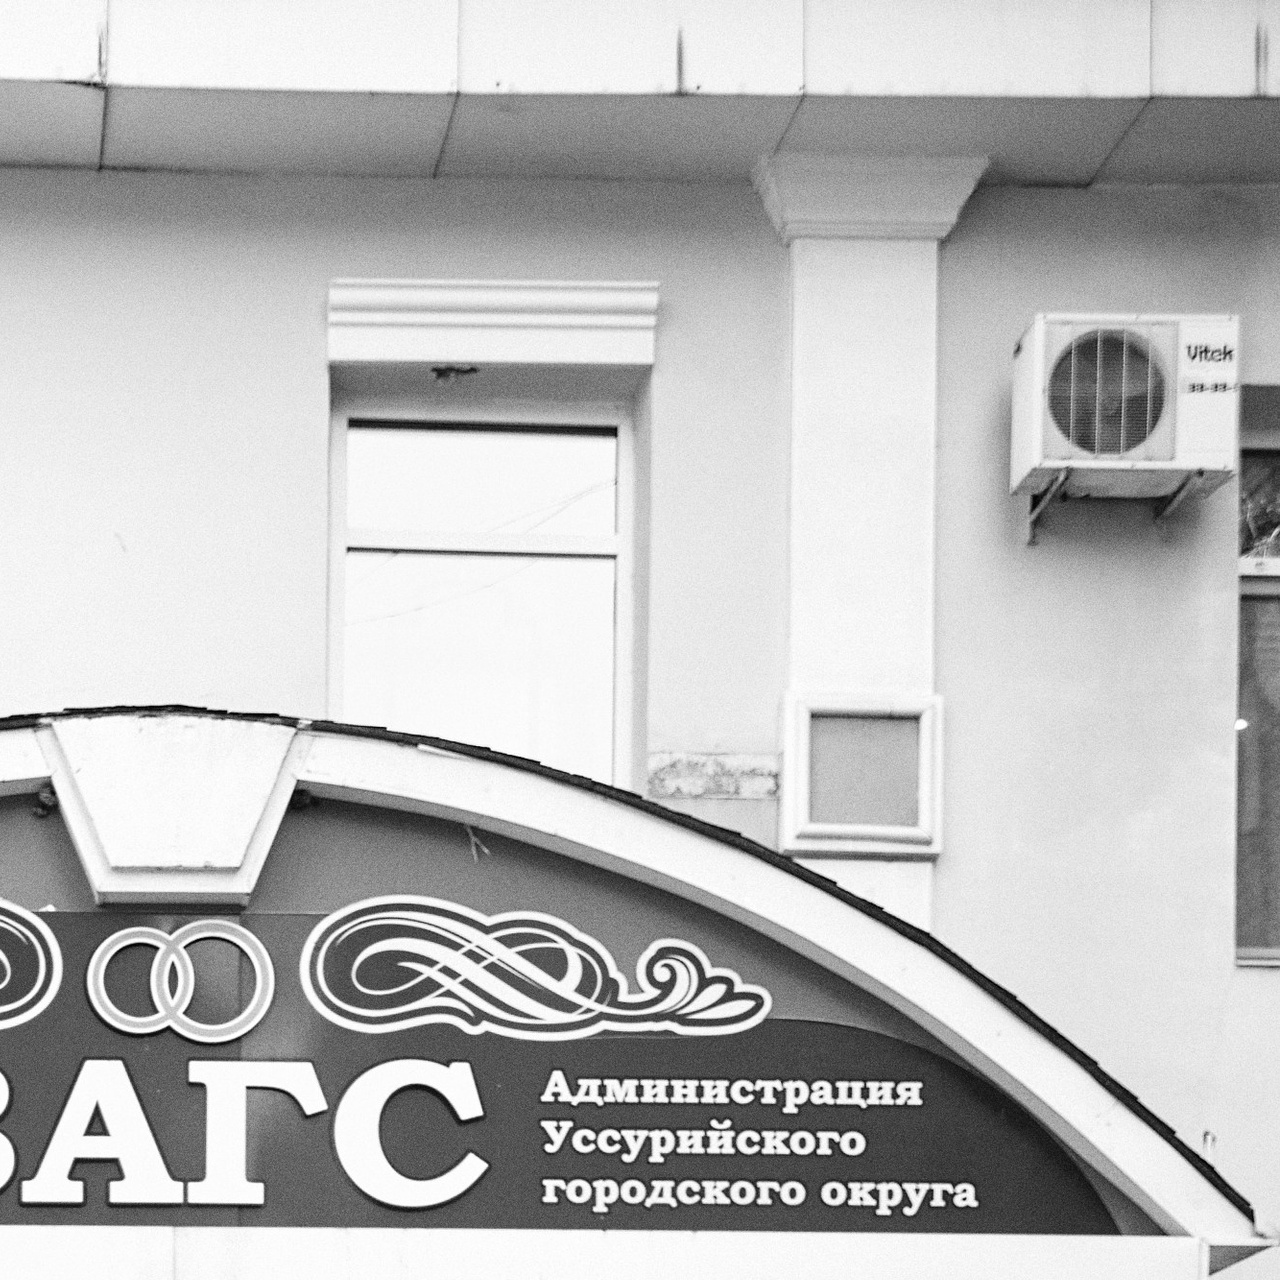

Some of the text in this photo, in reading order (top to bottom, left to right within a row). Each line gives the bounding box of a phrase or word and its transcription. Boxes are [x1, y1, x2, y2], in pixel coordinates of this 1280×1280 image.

[540, 1070, 923, 1114] Администрация
[540, 1118, 866, 1164] Уссурийского
[541, 1178, 979, 1217] городского округа
